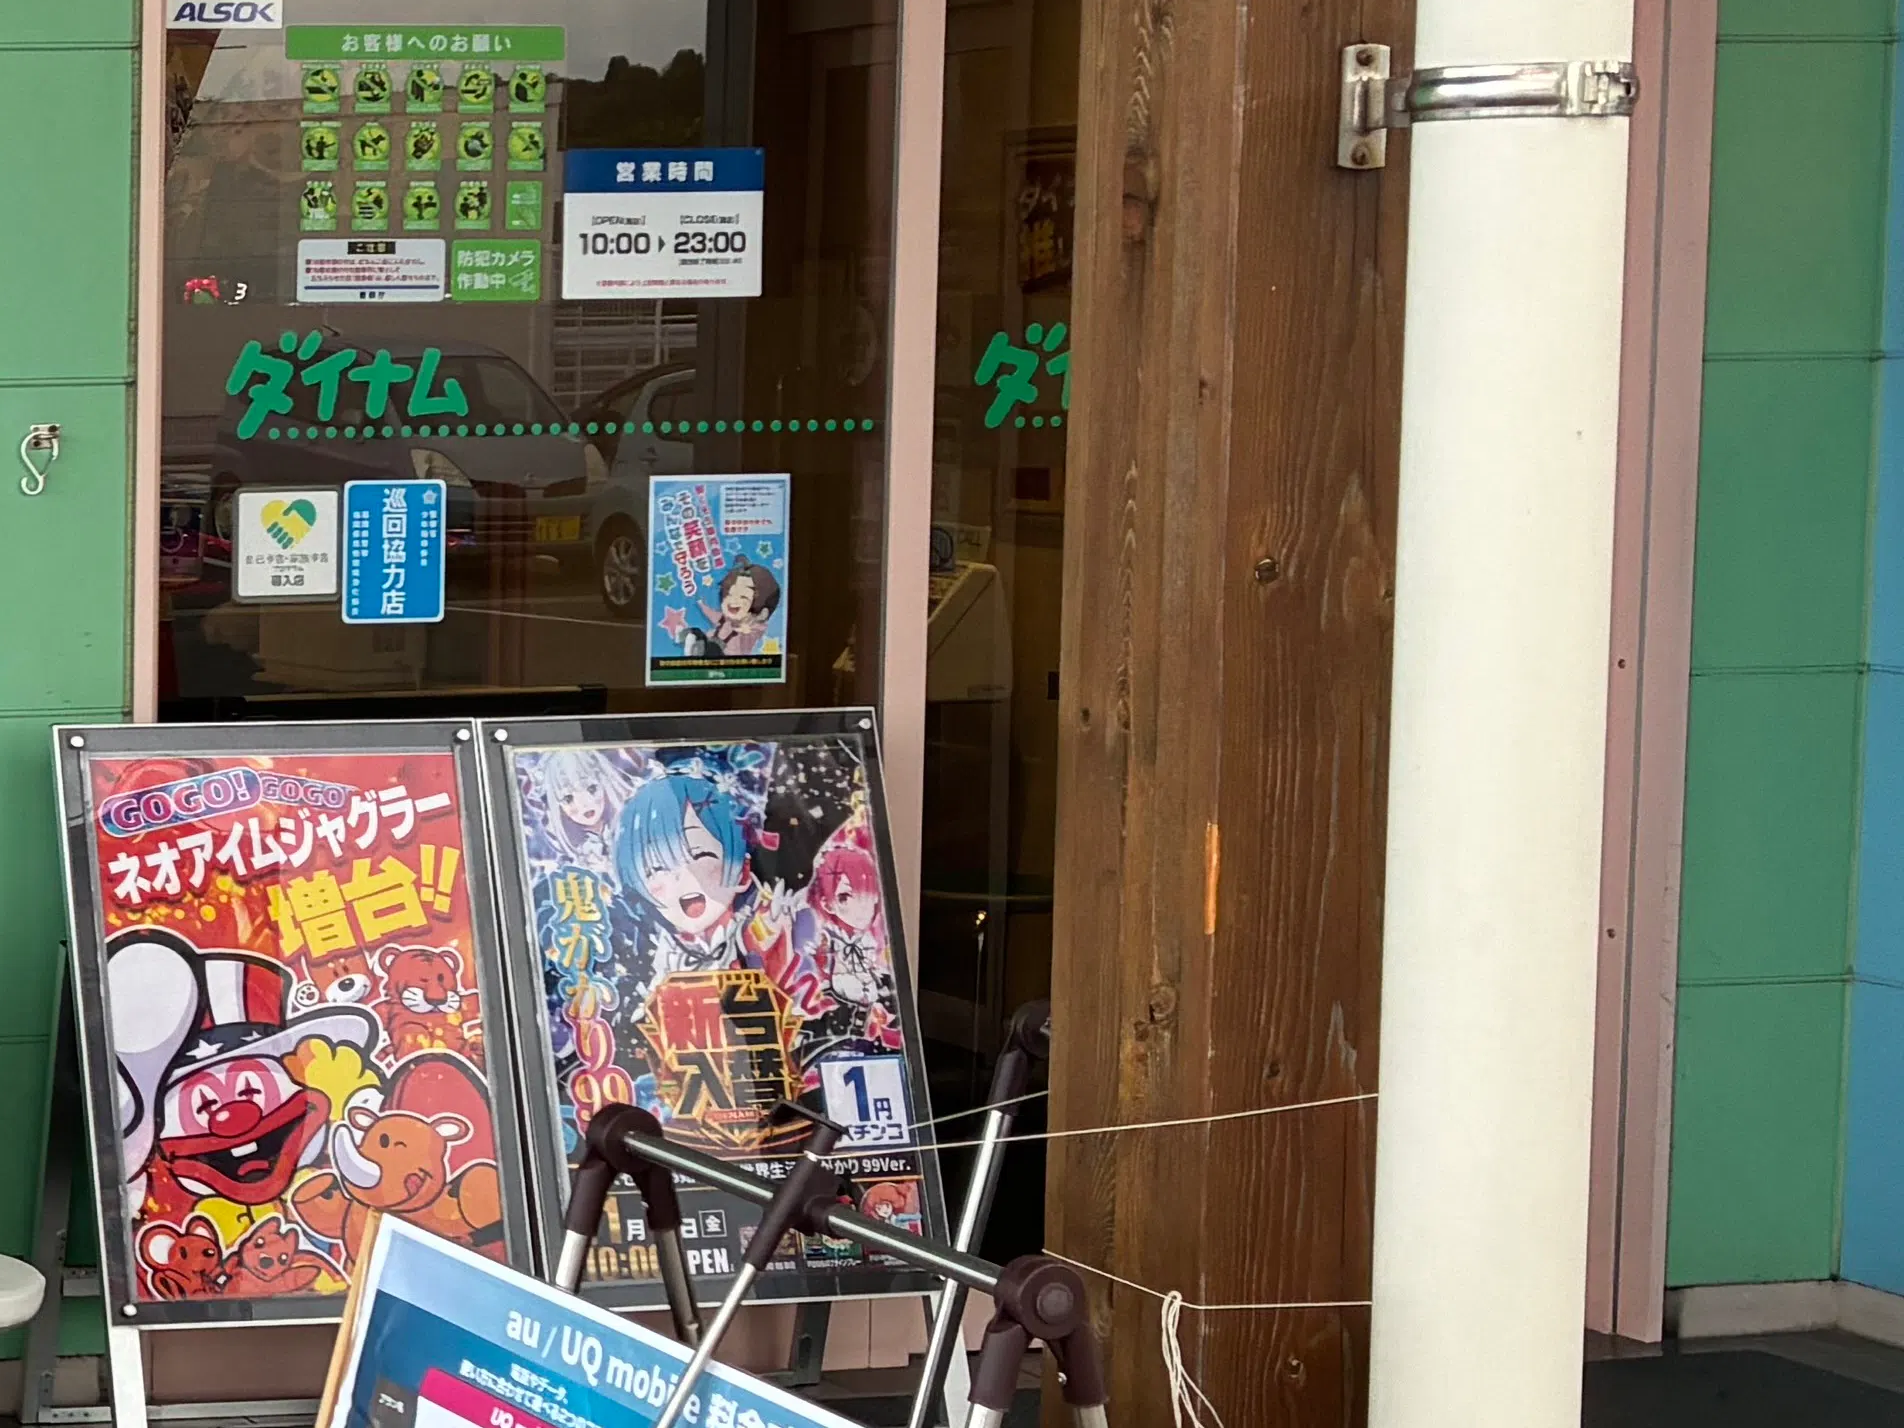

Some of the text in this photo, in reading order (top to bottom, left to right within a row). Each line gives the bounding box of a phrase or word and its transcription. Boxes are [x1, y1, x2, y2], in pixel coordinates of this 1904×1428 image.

[173, 2, 275, 23] ALSOK
[342, 33, 512, 53] お客様へのお願い
[616, 161, 714, 183] 営業時間
[579, 232, 651, 255] 10:00
[673, 231, 746, 254] 23:00
[457, 249, 535, 267] 防犯カメラ
[457, 272, 506, 290] 作動中
[225, 330, 469, 440] ダイナム
[380, 488, 408, 616] 巡回協力店
[111, 769, 247, 830] GOGO!
[108, 785, 452, 904] ネオアイムジャグラー
[503, 1308, 542, 1350] au
[553, 1323, 607, 1388] UQ
